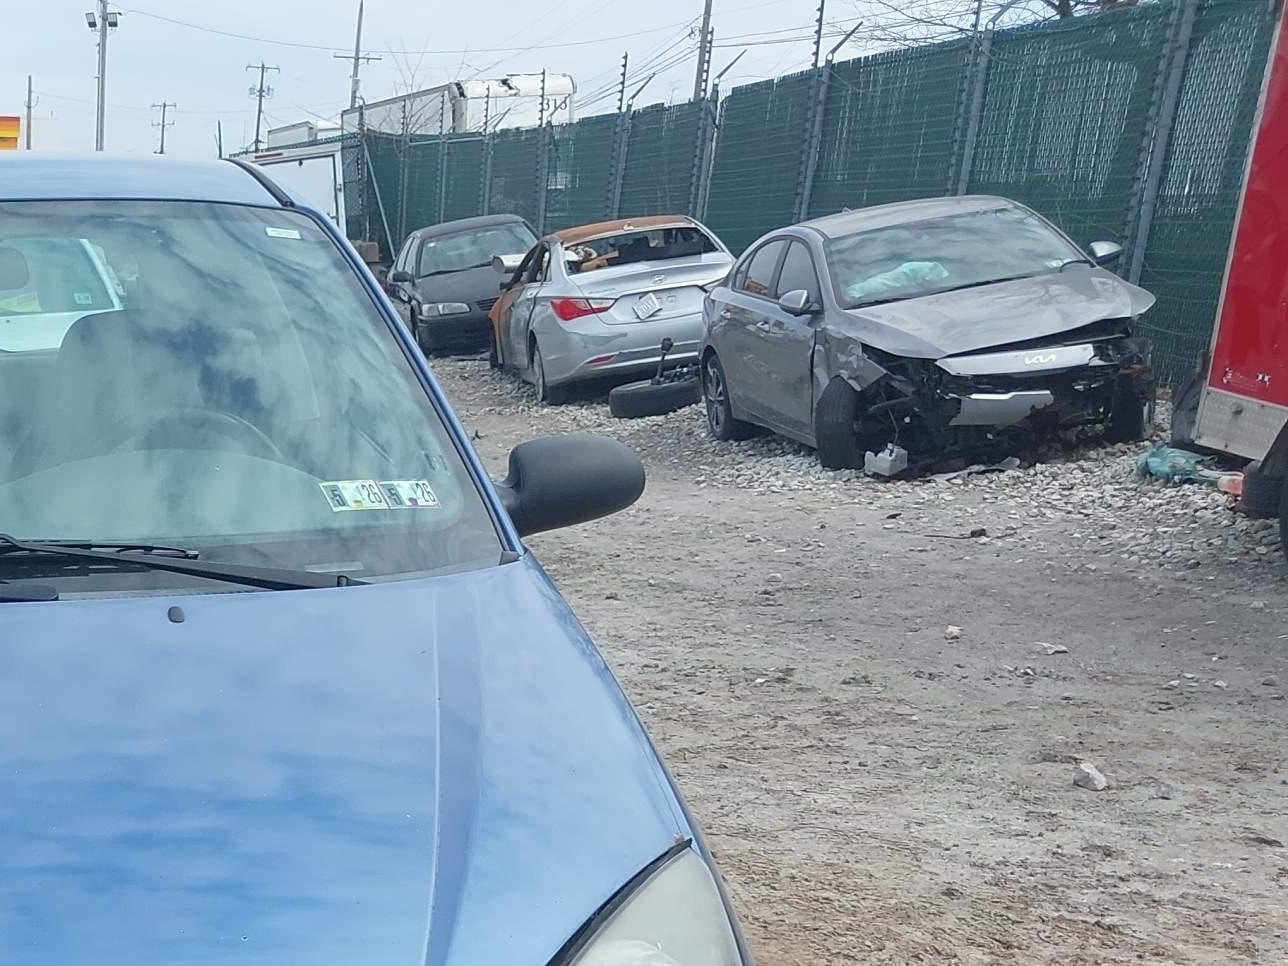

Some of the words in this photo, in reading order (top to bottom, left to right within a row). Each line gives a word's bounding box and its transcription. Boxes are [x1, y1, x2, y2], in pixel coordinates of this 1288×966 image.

[330, 488, 346, 507] 5
[361, 483, 383, 504] 26
[386, 487, 403, 506] 5
[415, 482, 436, 503] 26
